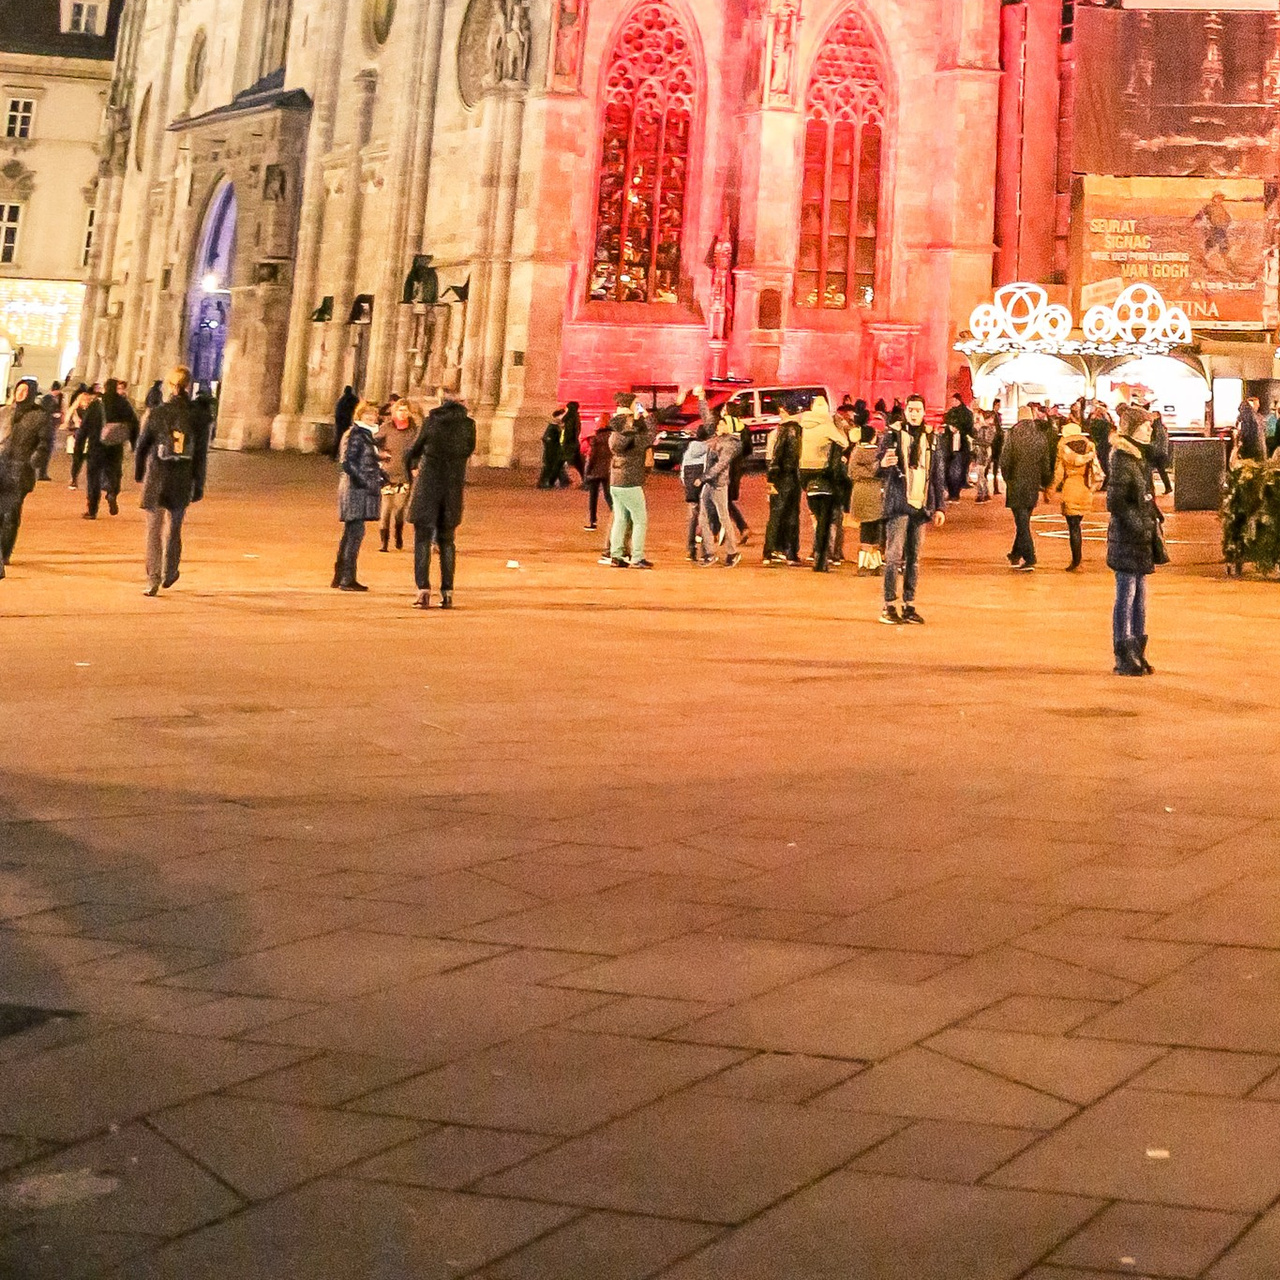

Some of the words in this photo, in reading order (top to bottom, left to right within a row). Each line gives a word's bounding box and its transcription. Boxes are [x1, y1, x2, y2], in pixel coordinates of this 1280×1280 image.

[1089, 218, 1138, 233] SEURAT
[1104, 235, 1152, 250] SIGNAC
[1121, 263, 1149, 278] VAN
[1152, 263, 1189, 278] GOGH
